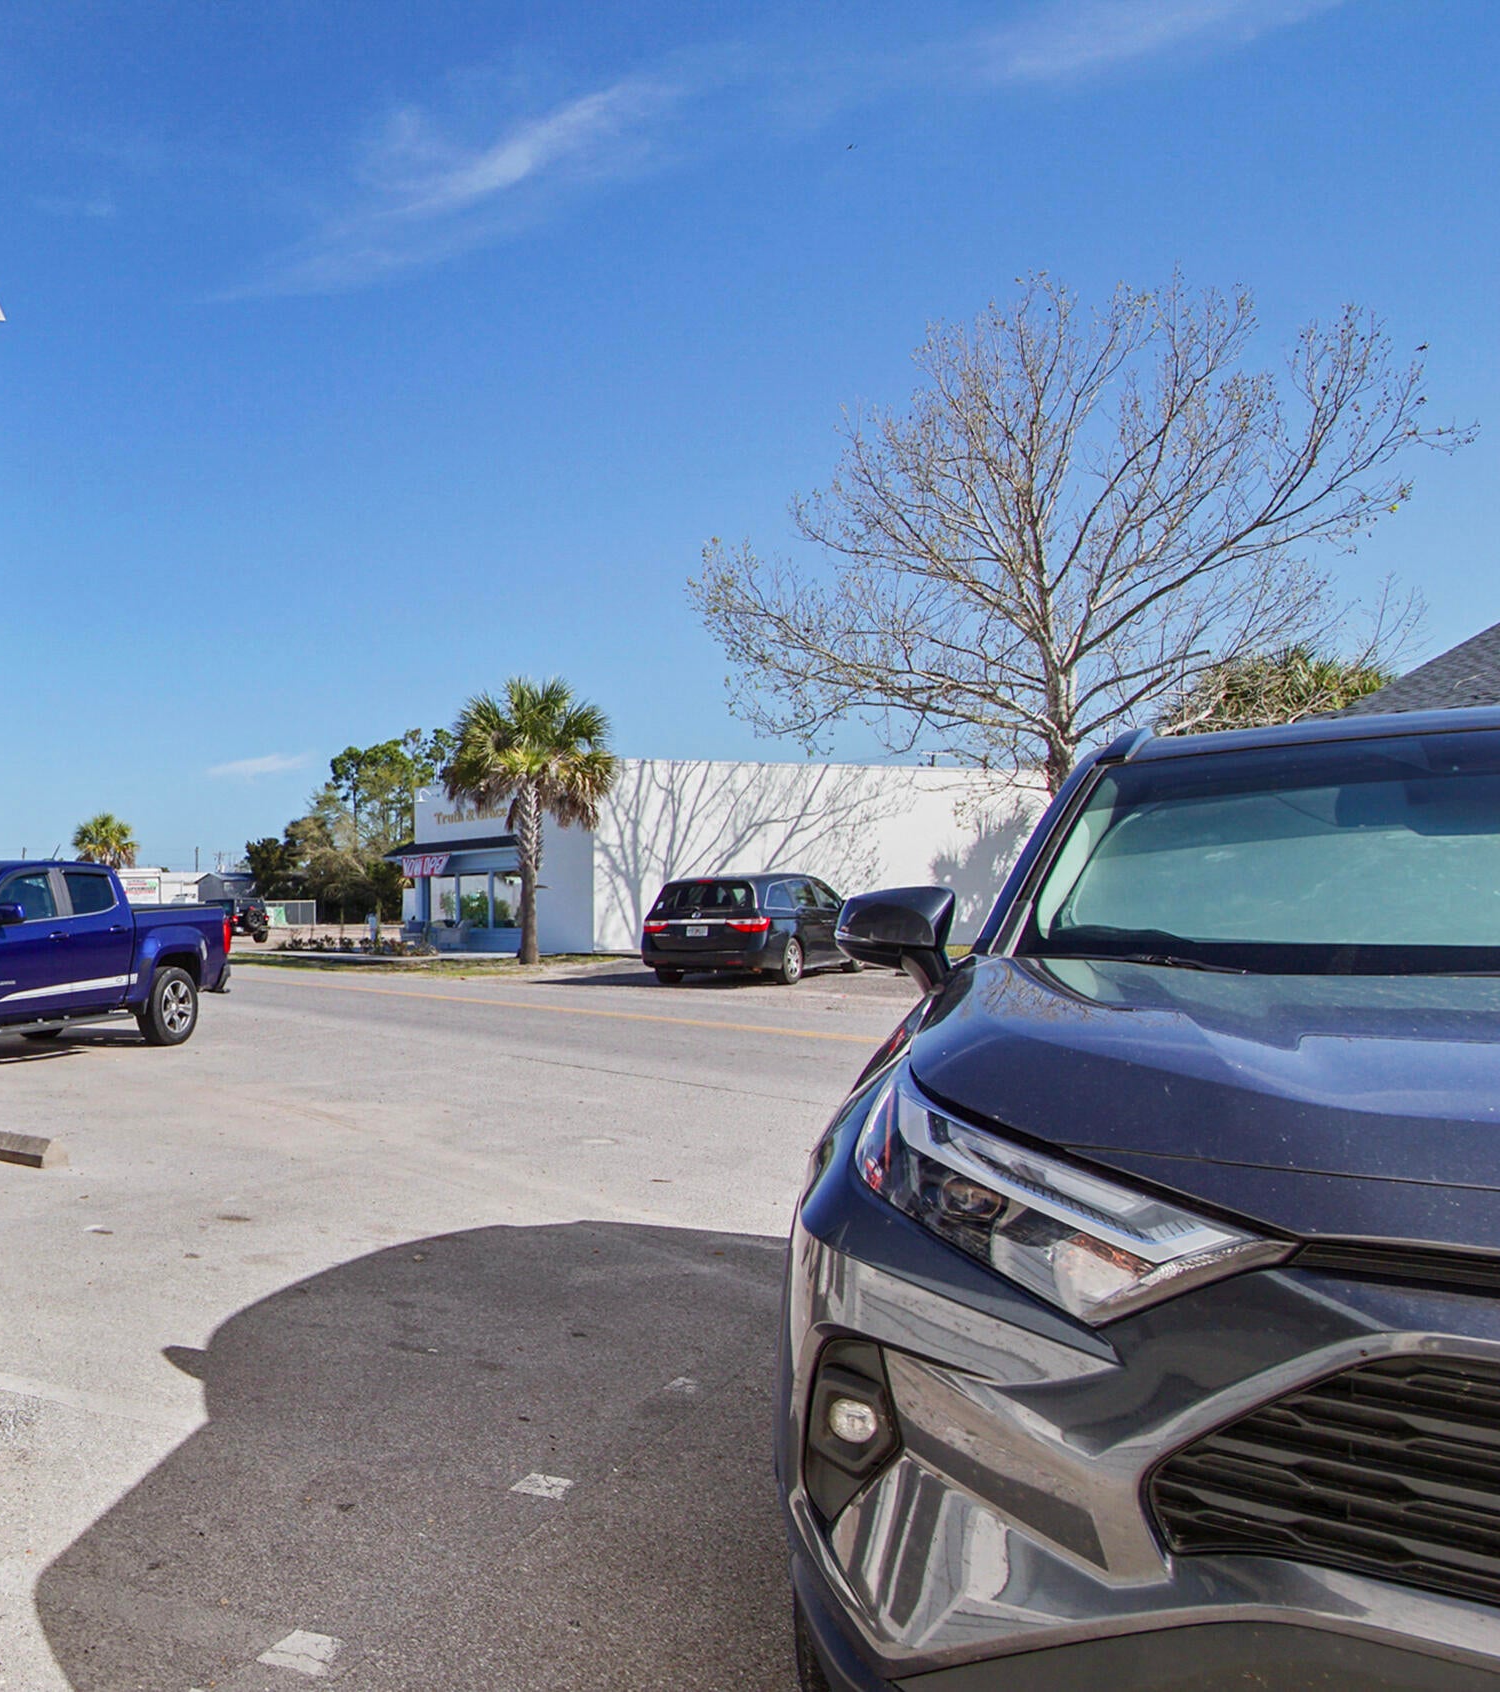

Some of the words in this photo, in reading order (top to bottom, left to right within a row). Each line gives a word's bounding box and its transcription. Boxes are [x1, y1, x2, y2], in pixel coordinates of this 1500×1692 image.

[434, 811, 464, 825] Truth
[466, 808, 475, 821] &
[402, 857, 422, 876] NOW
[423, 854, 449, 875] OPEN
